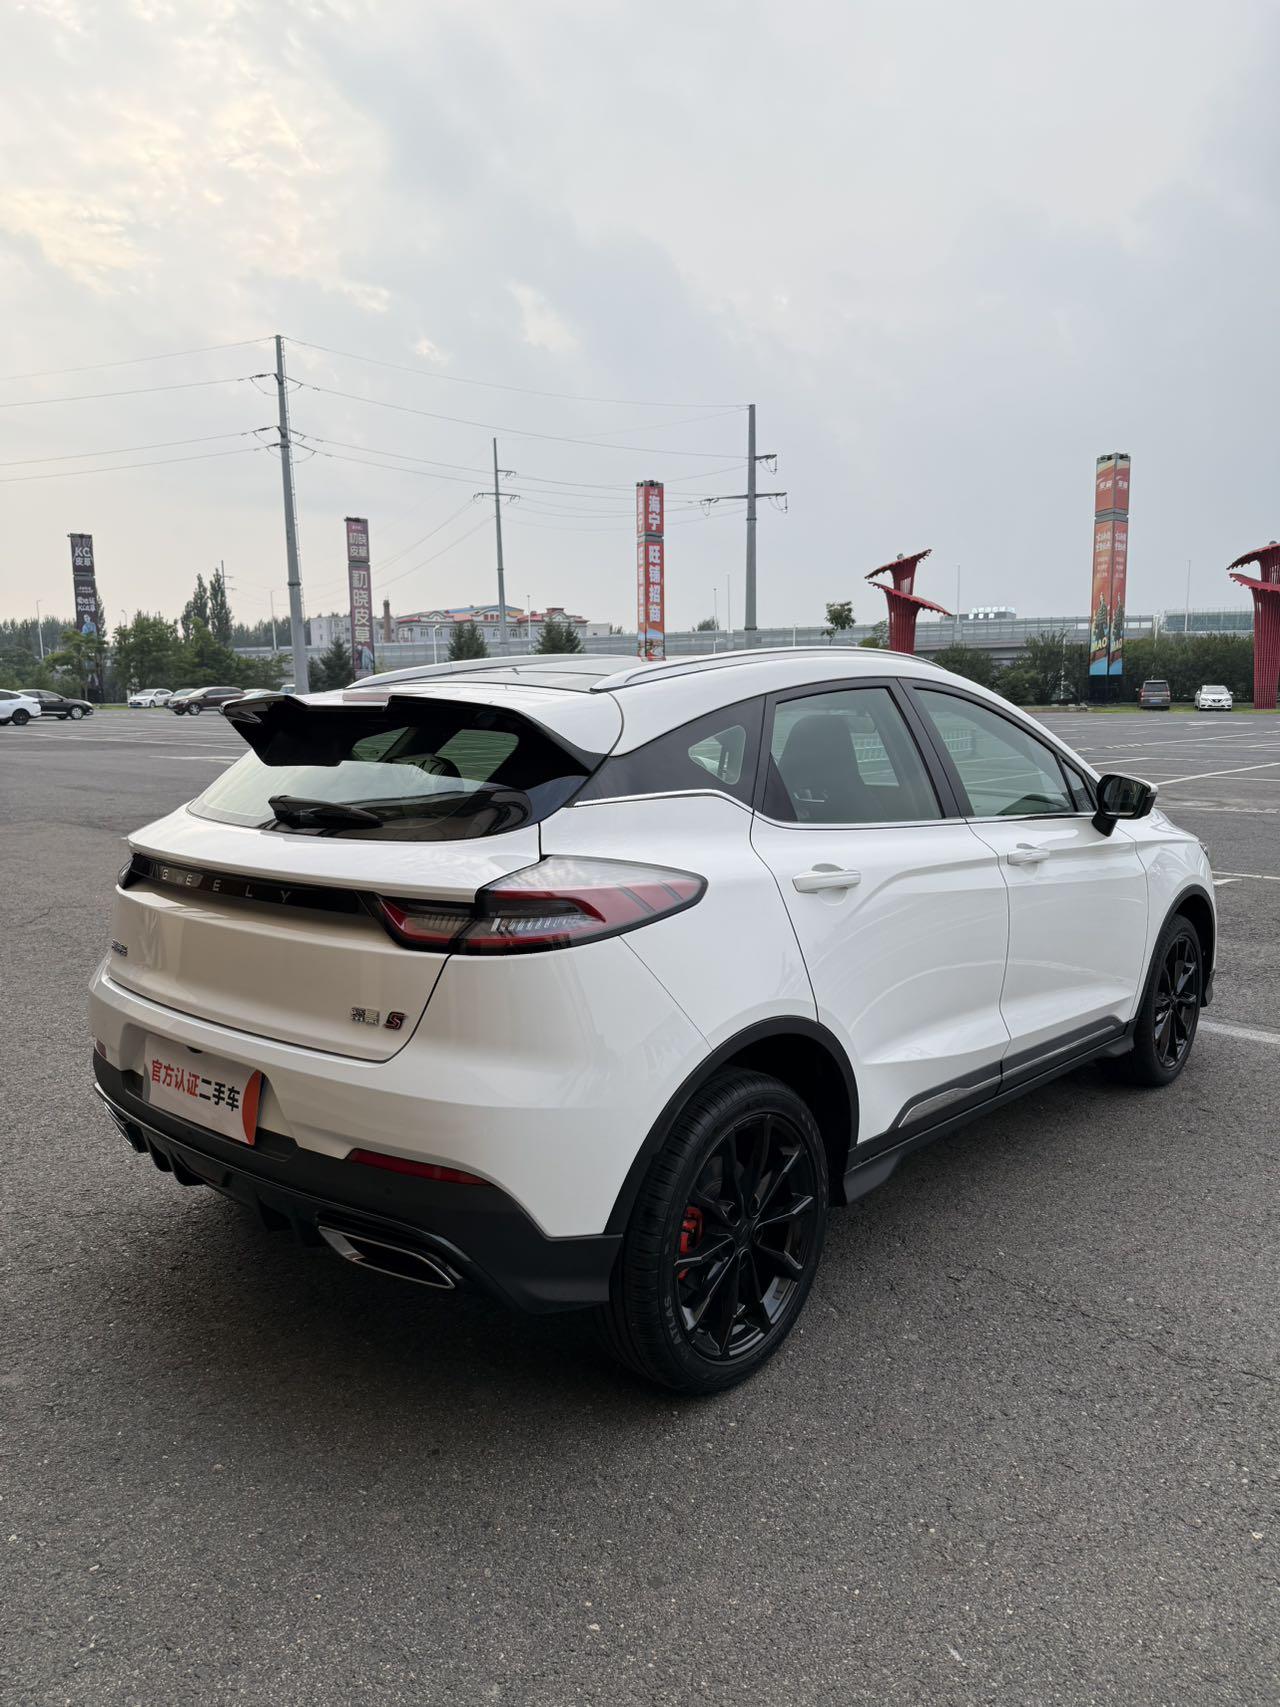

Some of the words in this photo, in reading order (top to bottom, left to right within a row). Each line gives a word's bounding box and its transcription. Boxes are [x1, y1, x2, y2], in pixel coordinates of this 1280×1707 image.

[162, 869, 291, 903] GEELY
[151, 1059, 240, 1112] 官方认证二手车
